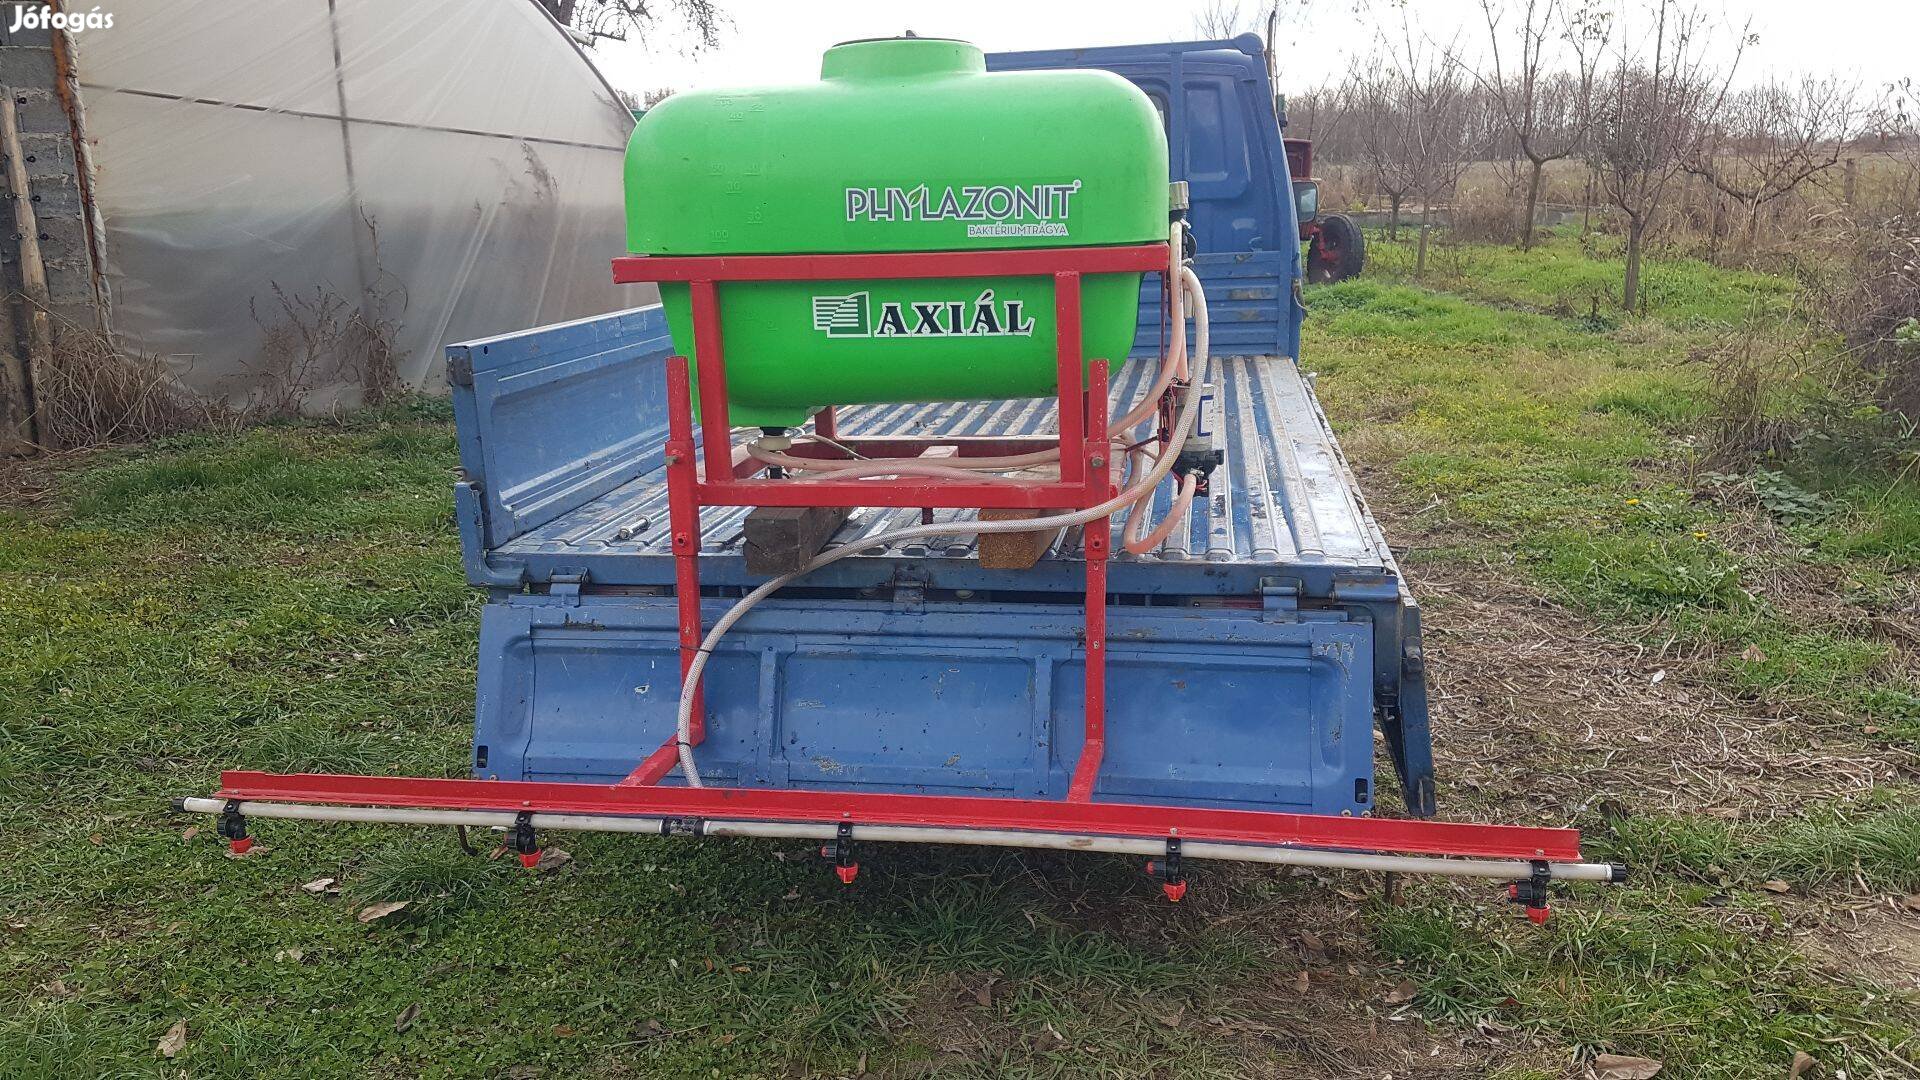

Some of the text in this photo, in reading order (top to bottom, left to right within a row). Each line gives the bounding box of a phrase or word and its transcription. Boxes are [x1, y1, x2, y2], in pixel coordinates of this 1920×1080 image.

[846, 184, 1077, 221] PHYLAZONIT
[968, 222, 1067, 236] BAKTÉRIUMTRÁGYA
[876, 290, 1034, 336] AXIÁL
